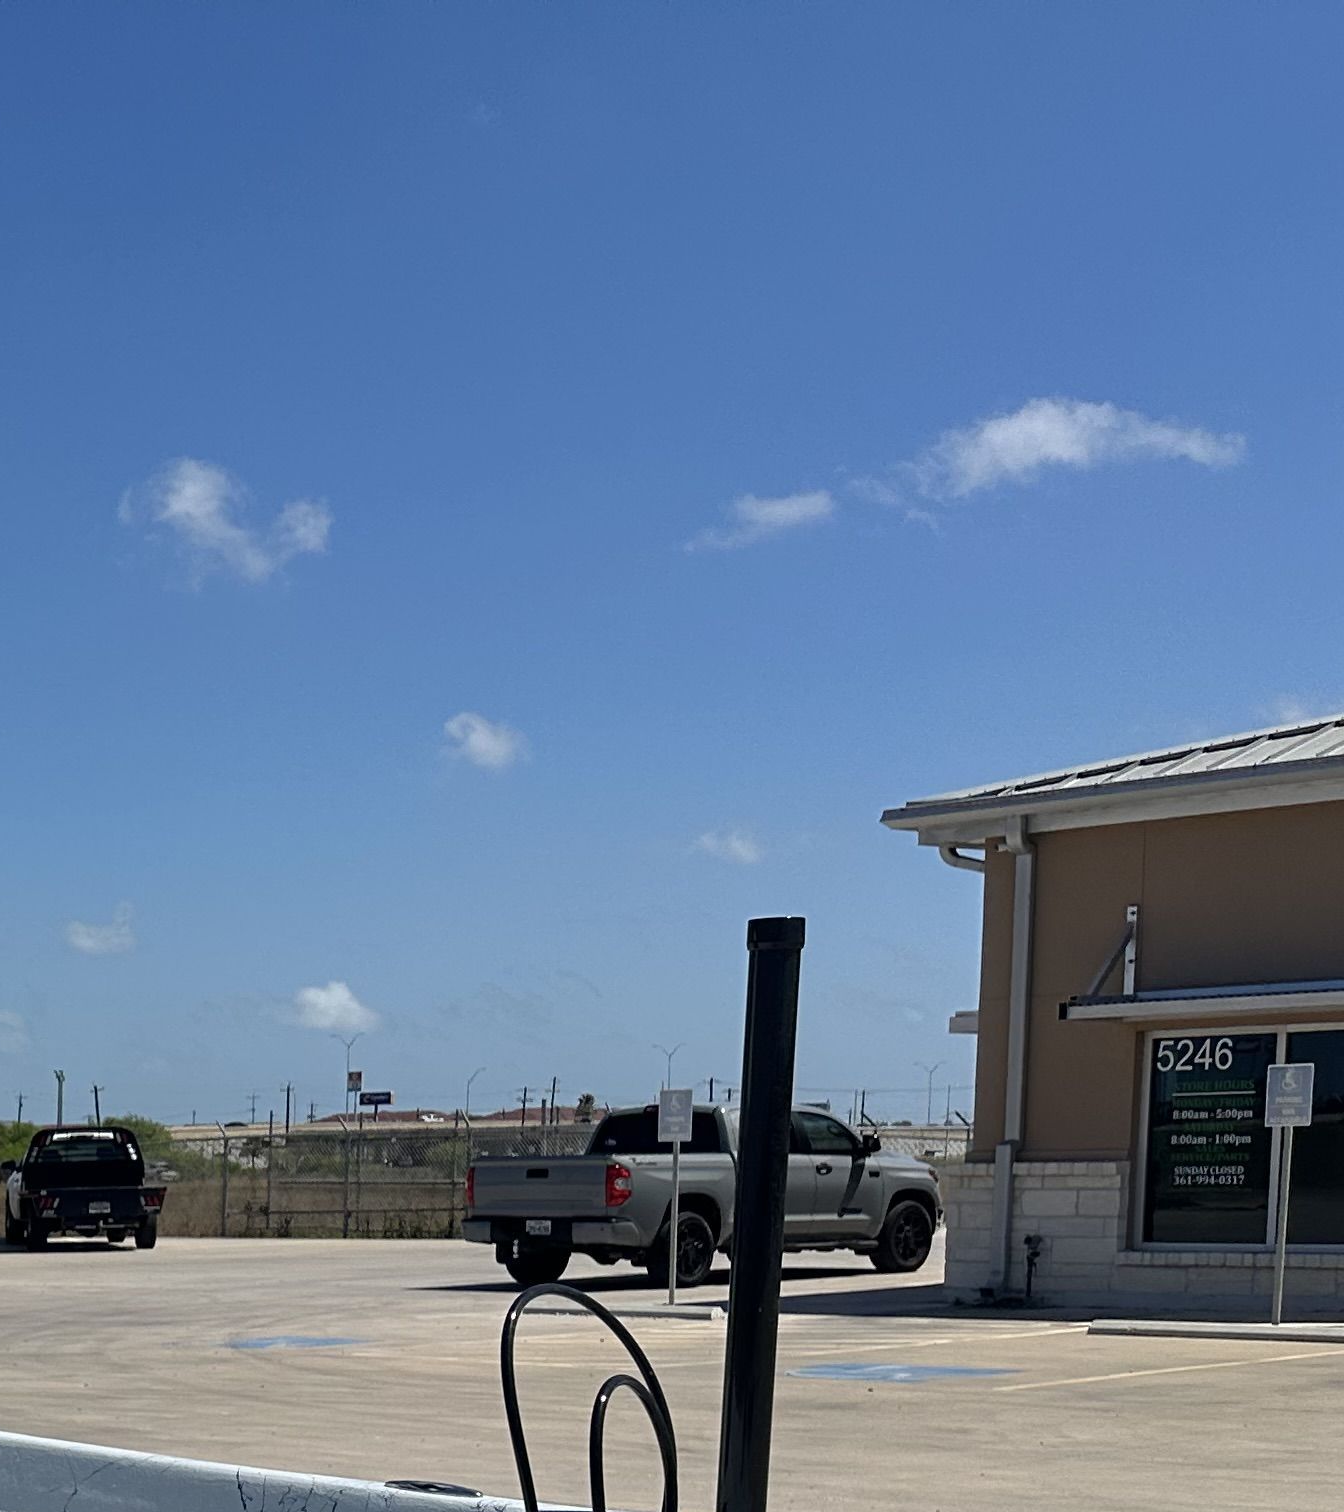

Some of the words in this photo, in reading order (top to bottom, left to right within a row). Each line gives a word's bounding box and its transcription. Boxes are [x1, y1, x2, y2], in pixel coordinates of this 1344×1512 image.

[1156, 1037, 1233, 1072] 5246
[1214, 1079, 1255, 1090] HOURS
[1215, 1108, 1254, 1121] 5:00pm
[1215, 1133, 1252, 1147] 1:00pm
[1174, 1165, 1209, 1175] SUNDAY
[1210, 1165, 1245, 1175] CLOSED
